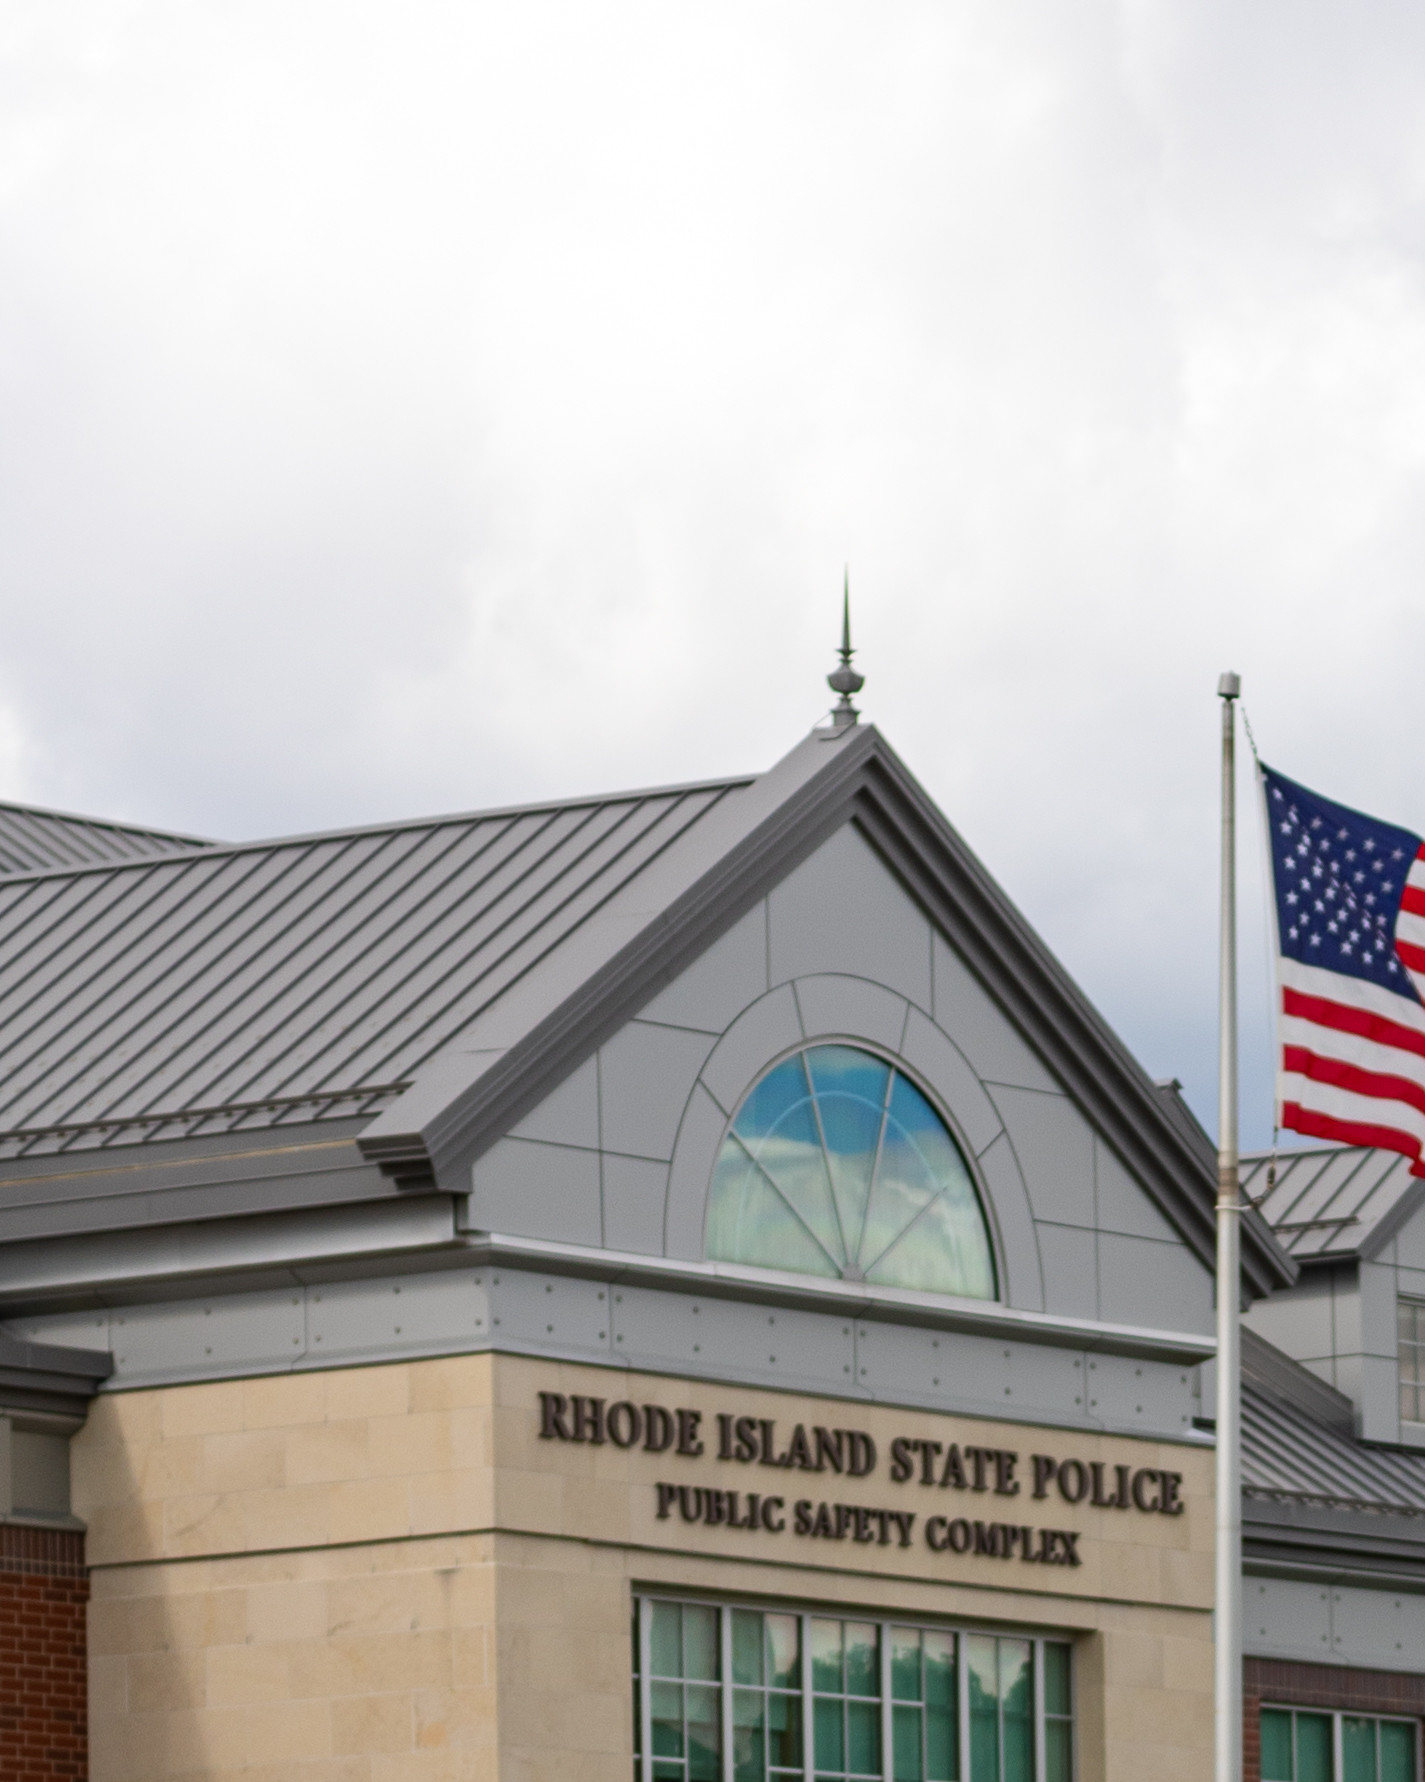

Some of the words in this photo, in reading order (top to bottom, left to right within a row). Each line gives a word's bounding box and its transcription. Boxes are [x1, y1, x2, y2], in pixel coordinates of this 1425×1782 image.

[538, 1391, 702, 1458] RHODE
[716, 1414, 876, 1478] ISLAND
[890, 1437, 1019, 1497] STATE
[1031, 1455, 1184, 1516] POLICE
[655, 1482, 784, 1532] PUBLIC
[794, 1500, 915, 1548] SAFETY
[927, 1515, 1082, 1567] COMPLEX
